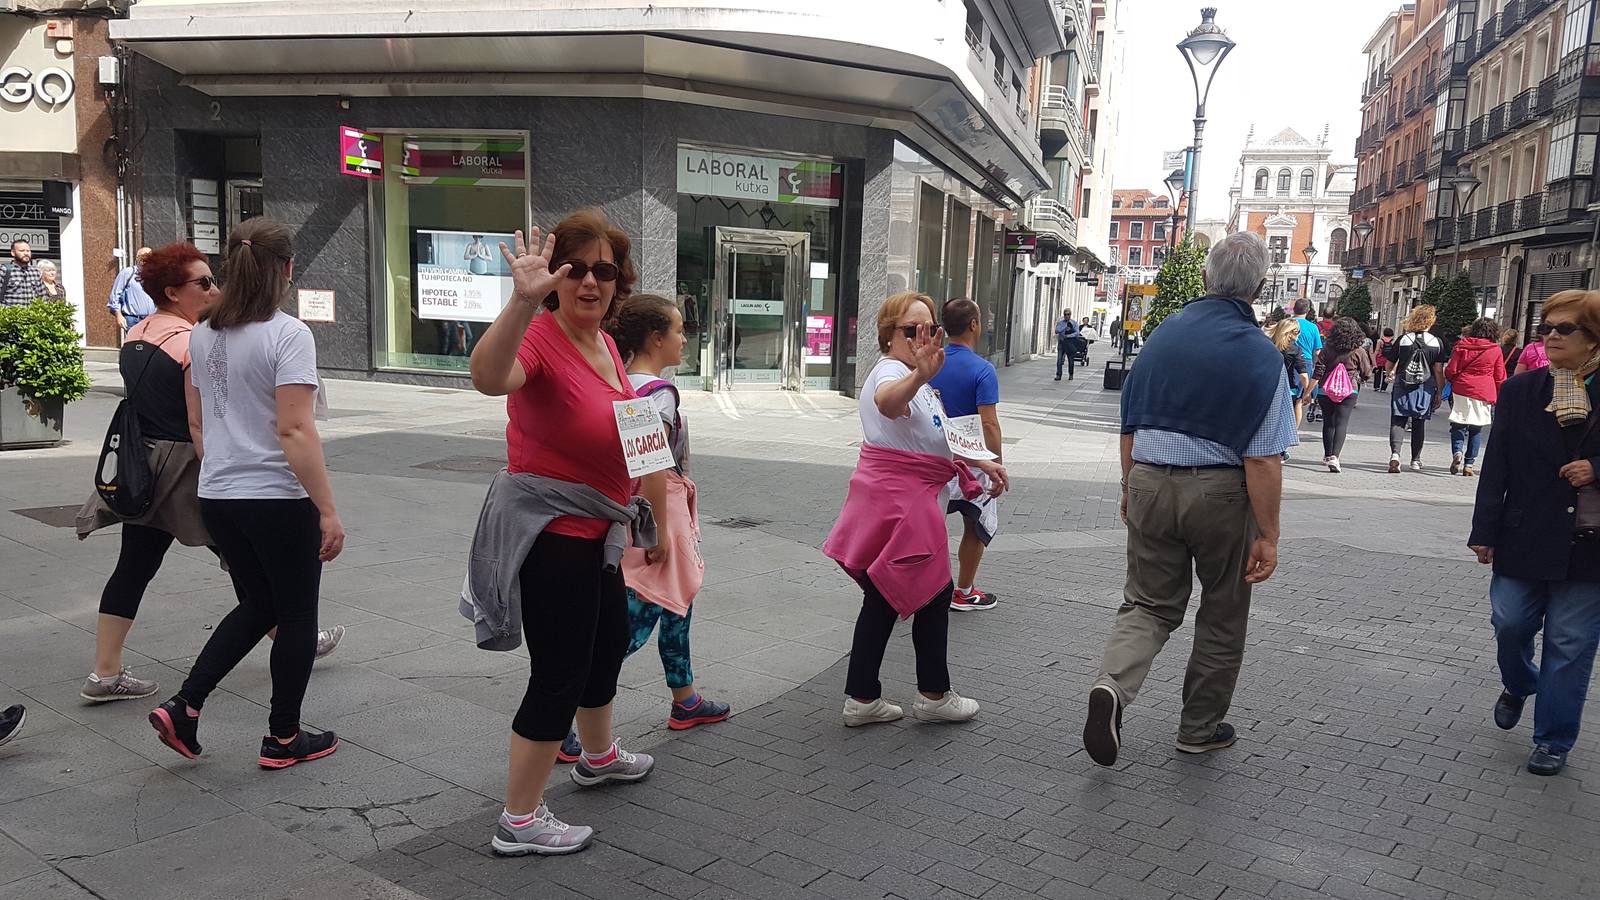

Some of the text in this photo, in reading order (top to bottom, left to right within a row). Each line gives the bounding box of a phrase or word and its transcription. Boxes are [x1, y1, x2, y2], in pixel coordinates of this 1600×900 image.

[211, 101, 222, 121] 2
[452, 155, 503, 167] LABORAL
[481, 166, 503, 175] kutxa
[686, 156, 769, 181] LABORAL
[735, 180, 769, 194] kutxa
[51, 206, 72, 214] MANGO
[430, 274, 462, 282] HIPOTECA
[421, 288, 458, 297] HIPOTECA
[422, 297, 458, 307] ESTABLE
[623, 427, 667, 459] LOS GARCÍA
[947, 430, 985, 452] LOS GARCÍA
